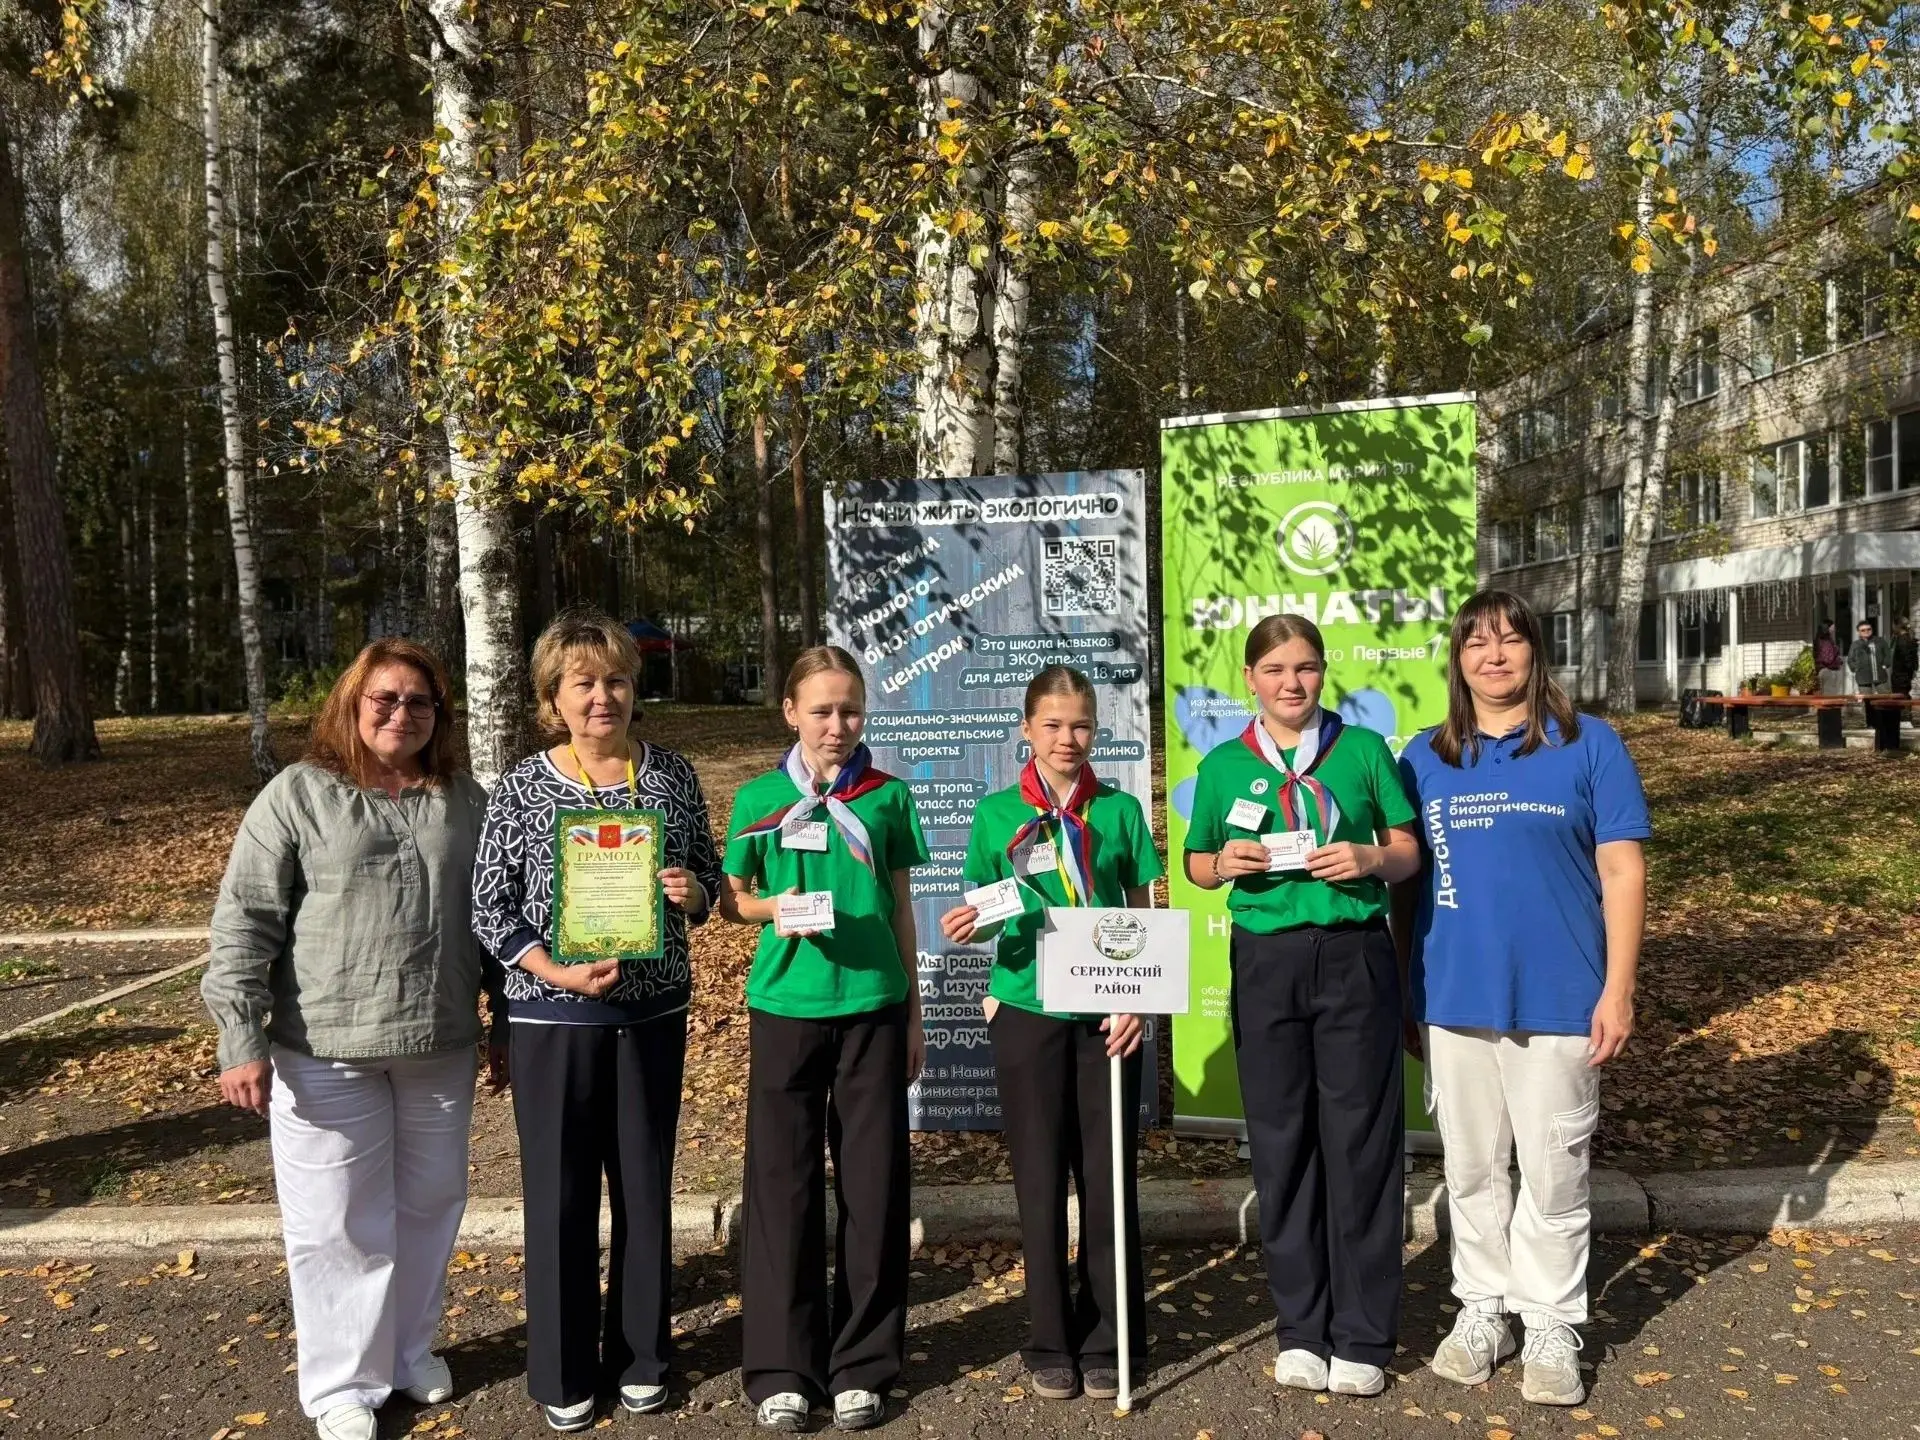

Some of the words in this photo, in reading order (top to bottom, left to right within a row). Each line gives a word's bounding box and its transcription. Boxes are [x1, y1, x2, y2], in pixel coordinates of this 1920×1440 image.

[1217, 469, 1324, 488] РЕСПУБЛИКА
[1392, 462, 1415, 476] ЭЛ
[842, 501, 912, 523] Начни
[922, 504, 976, 521] жить
[986, 497, 1119, 519] экологично
[850, 536, 941, 600] Детским
[863, 563, 1024, 665] биологическим
[1192, 586, 1446, 631] ЮННАТЫ
[980, 638, 1005, 650] Это
[1010, 637, 1053, 650] школа
[1057, 637, 1115, 649] навыков
[1008, 652, 1088, 668] ЭКОуспеха
[1353, 645, 1426, 665] Первые
[882, 634, 969, 695] центром
[964, 674, 990, 685] для
[994, 669, 1034, 684] детей
[1093, 667, 1108, 679] 18
[1111, 668, 1137, 679] лет
[1190, 698, 1249, 708] изучающих
[871, 711, 1019, 727] социально-значимые
[1190, 710, 1197, 718] и
[870, 728, 1005, 743] исследовательские
[902, 745, 960, 760] проекты
[1090, 746, 1139, 757] опинка
[933, 783, 973, 797] тропа
[1450, 791, 1508, 804] эколого
[915, 799, 953, 810] класс
[1449, 802, 1565, 817] биологический
[1450, 817, 1494, 830] центр
[577, 851, 642, 862] ГРАМОТА
[1426, 798, 1459, 909] Детский
[1070, 965, 1162, 978] СЕРНУРСКИЙ
[947, 982, 990, 997] изуч
[1094, 982, 1141, 995] РАЙОН
[955, 1030, 990, 1044] луч
[940, 1069, 947, 1078] в
[914, 1105, 924, 1115] и
[928, 1105, 972, 1119] науки
